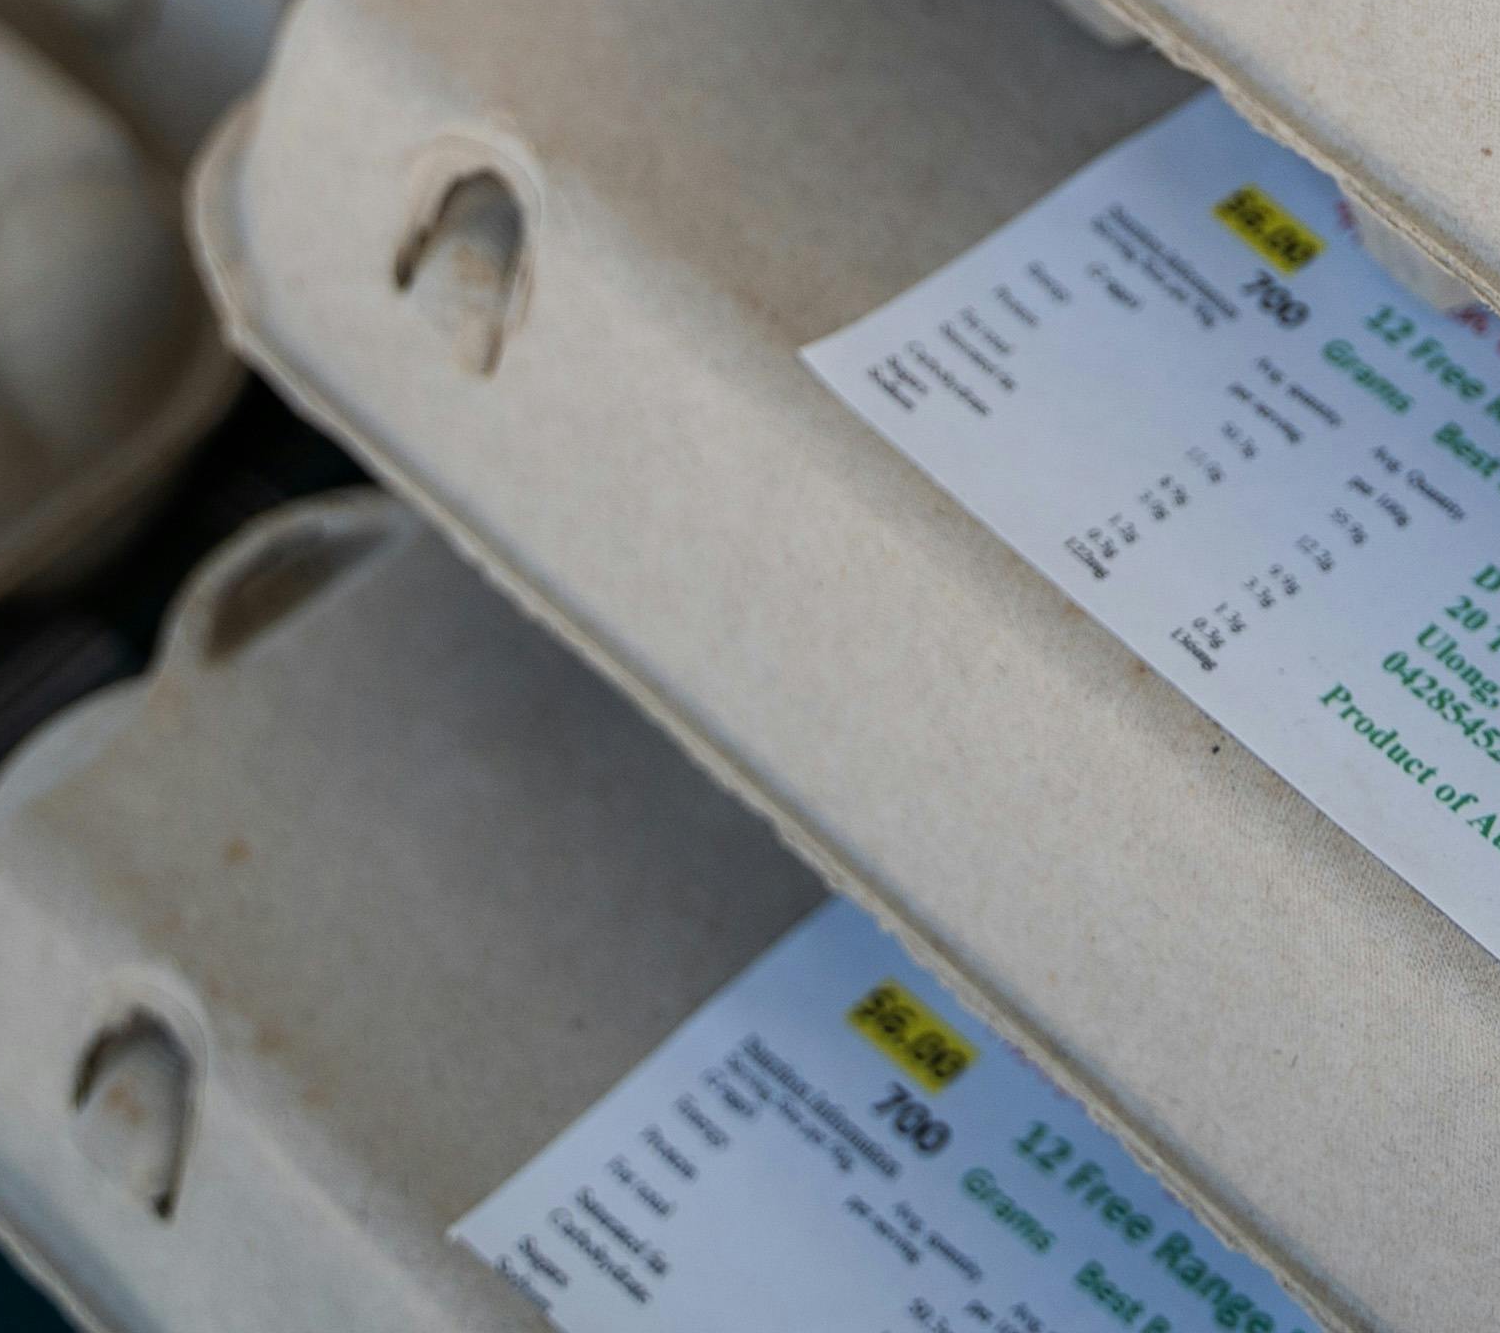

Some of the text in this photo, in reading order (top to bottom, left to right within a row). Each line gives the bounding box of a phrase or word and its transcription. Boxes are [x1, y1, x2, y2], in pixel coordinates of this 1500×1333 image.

[1242, 270, 1310, 329] 700
[1321, 339, 1414, 415] Grams
[1366, 304, 1417, 346] 12
[1409, 337, 1487, 402] Free
[1416, 622, 1500, 710] Ulong,
[1444, 595, 1490, 632] 20
[1319, 683, 1438, 785] Product
[1434, 784, 1480, 813] of
[873, 1082, 952, 1157] 700
[961, 1167, 1057, 1254] Grams
[1072, 1259, 1144, 1325] Best
[1016, 1121, 1275, 1333] 12 Free Range
